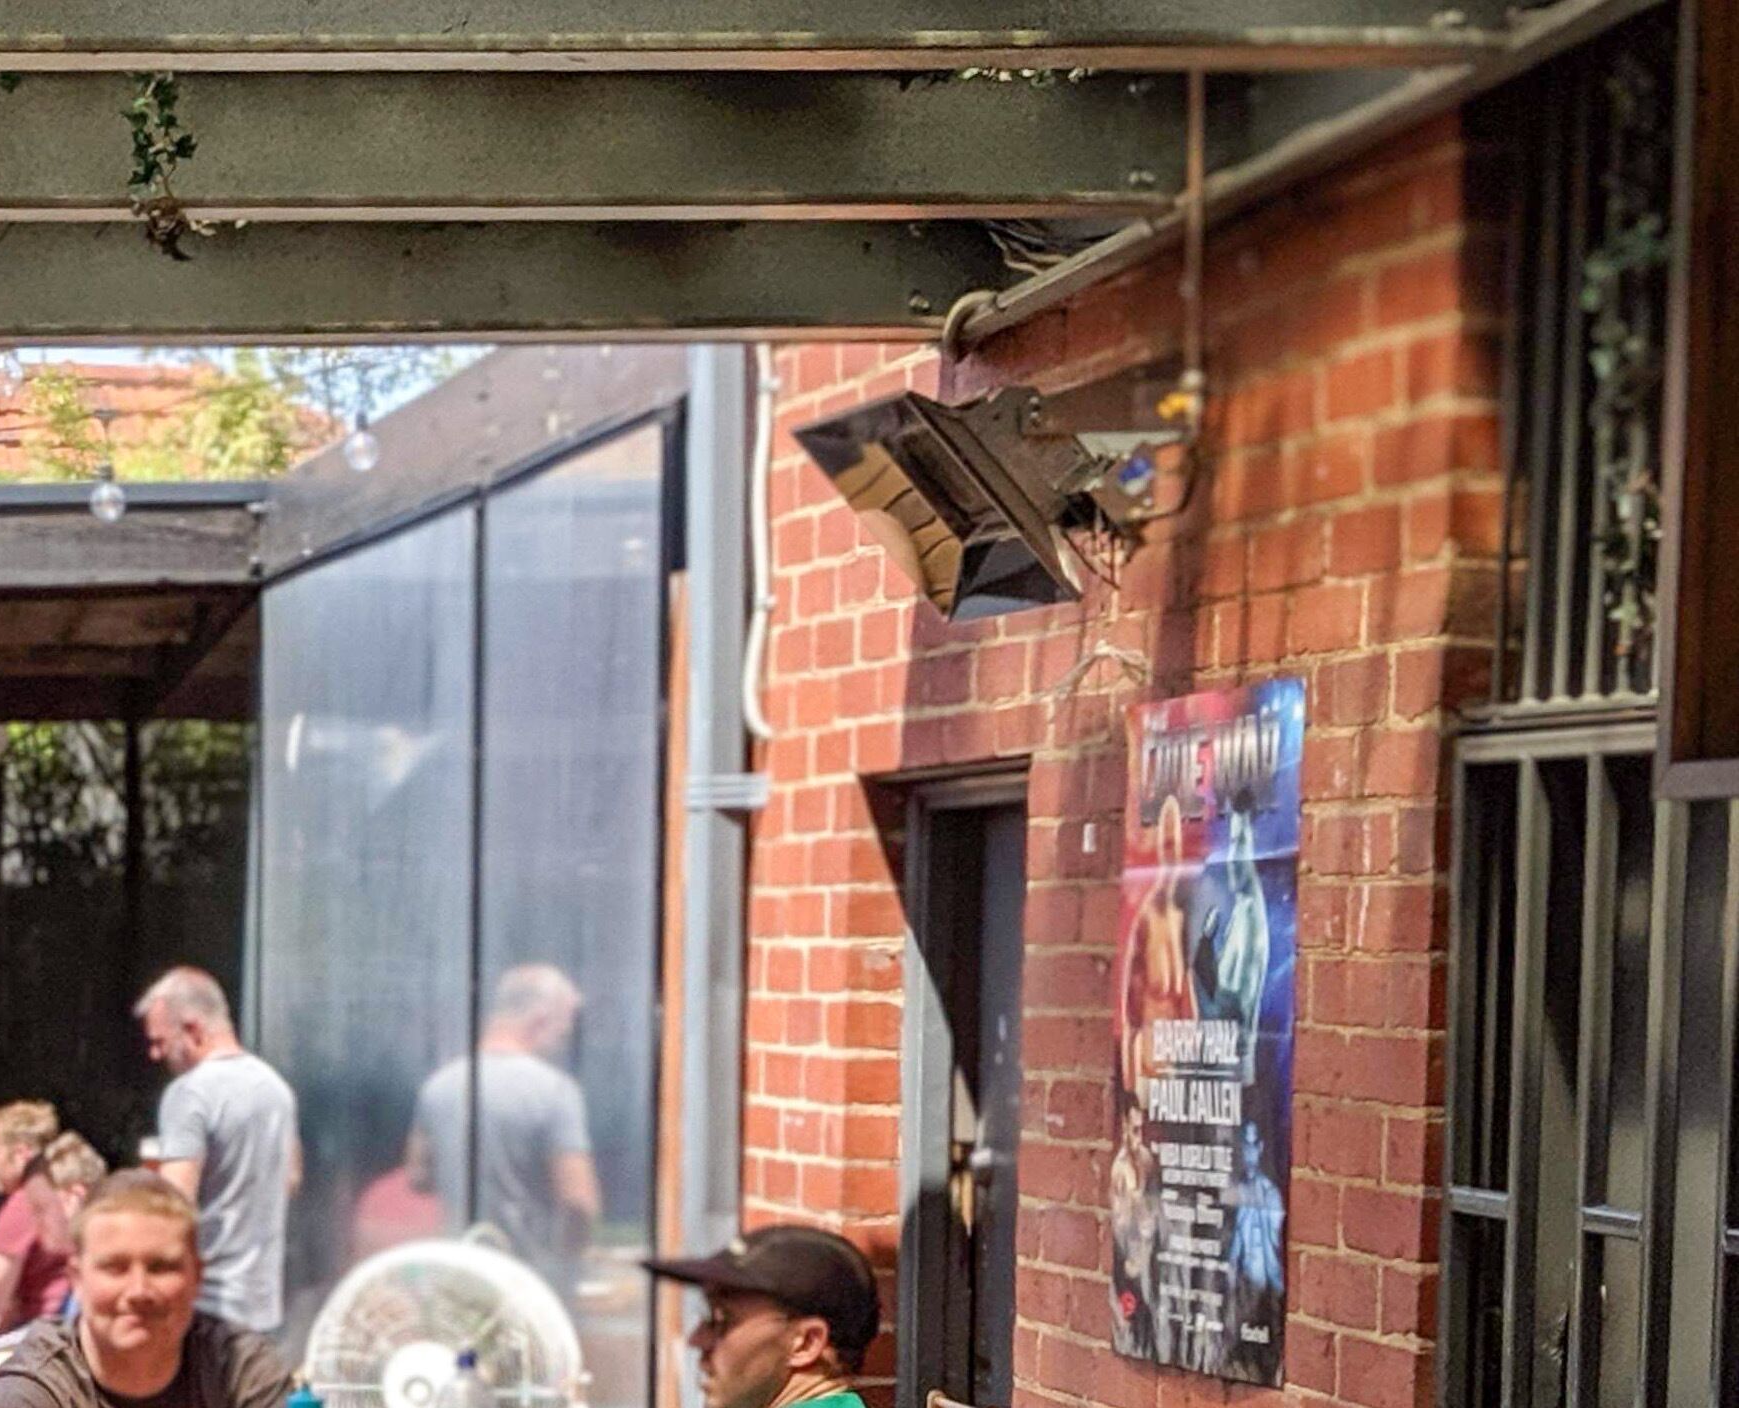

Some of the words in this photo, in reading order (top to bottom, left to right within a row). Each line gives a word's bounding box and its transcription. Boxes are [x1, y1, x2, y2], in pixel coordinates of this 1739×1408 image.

[1152, 1018, 1203, 1063] BARRY
[1147, 1077, 1188, 1123] PAUL
[1187, 1080, 1242, 1126] GALLEN
